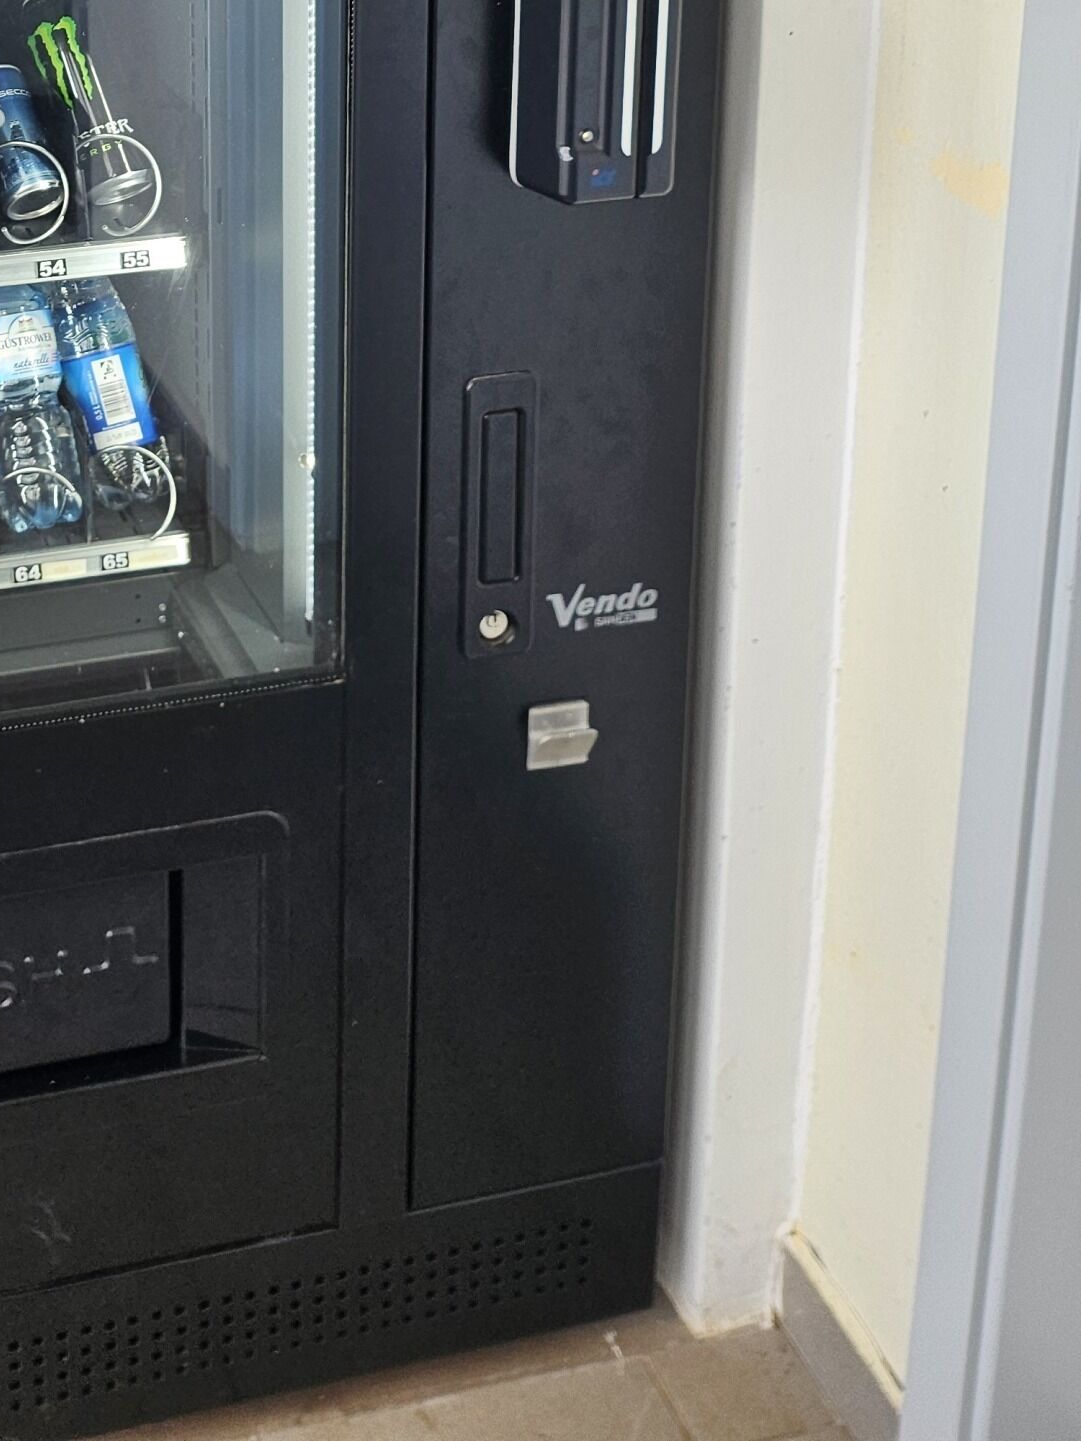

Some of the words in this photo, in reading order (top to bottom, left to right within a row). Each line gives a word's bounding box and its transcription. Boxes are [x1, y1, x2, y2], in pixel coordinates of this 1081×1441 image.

[124, 251, 150, 267] 55
[39, 261, 66, 277] 54
[103, 553, 127, 569] 65
[15, 565, 41, 581] 64
[545, 582, 659, 628] Vendo
